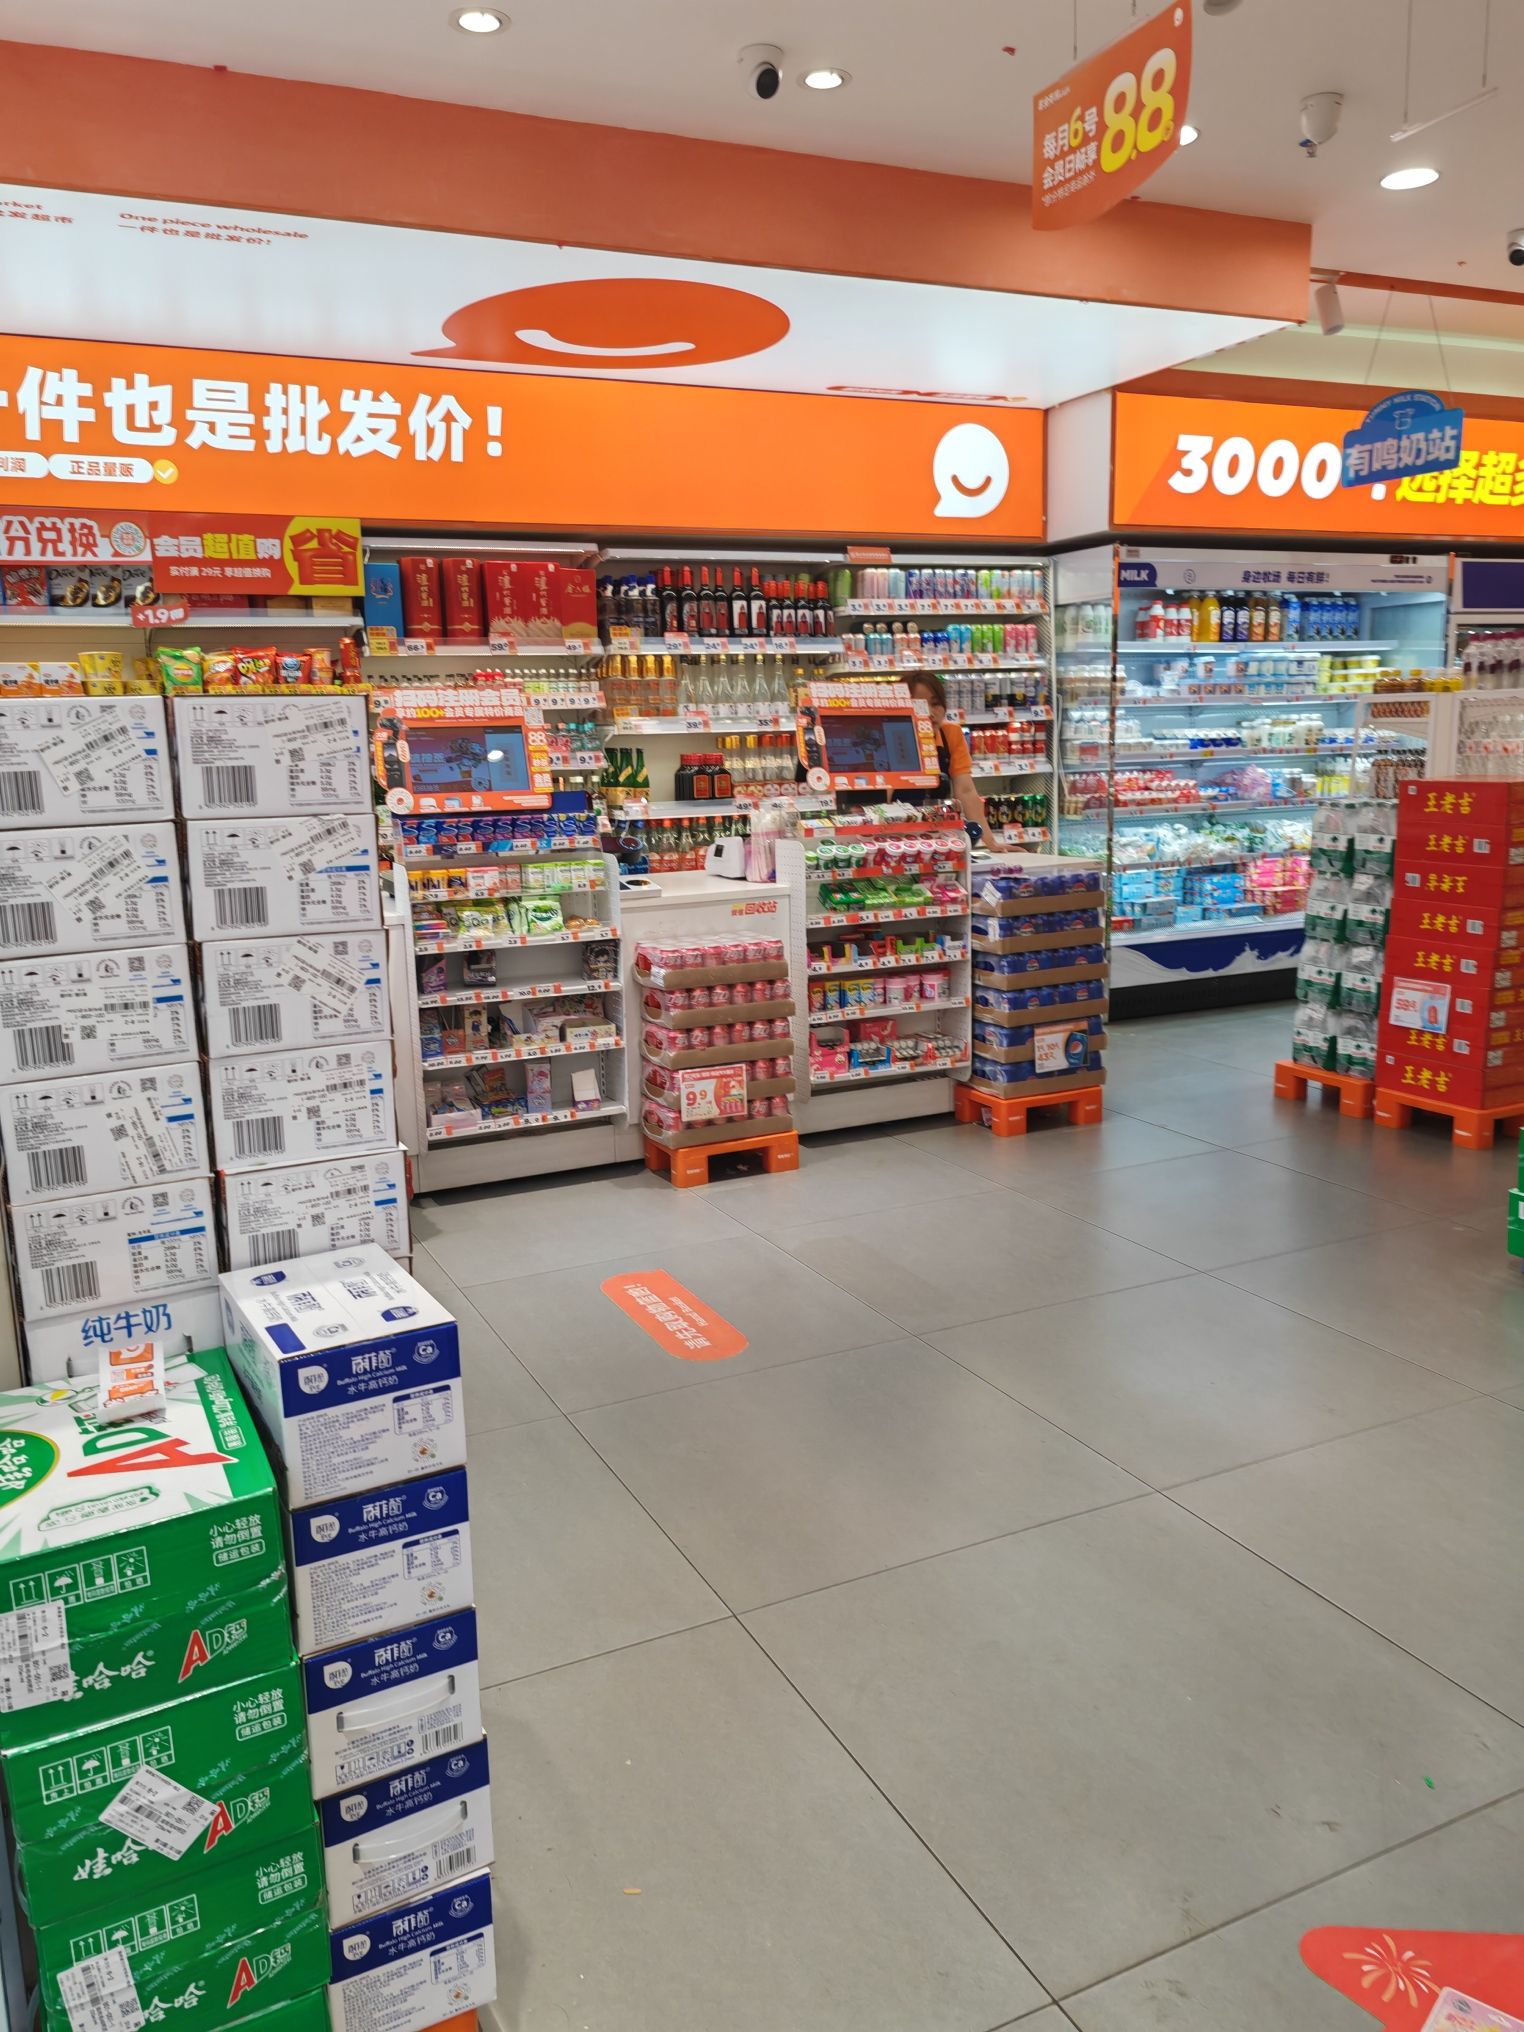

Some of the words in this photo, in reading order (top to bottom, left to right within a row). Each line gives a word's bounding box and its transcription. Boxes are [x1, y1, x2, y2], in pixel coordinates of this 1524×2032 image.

[1042, 106, 1098, 160] 每月6号
[119, 213, 158, 224] One
[162, 217, 212, 229] piece
[216, 223, 310, 239] wholesale
[0, 365, 503, 463] 件也是批发价!
[1345, 426, 1458, 478] 有鸣奶站
[69, 459, 135, 478] 正品量贩
[153, 533, 281, 559] 会员超值购
[289, 528, 360, 586] 省
[1120, 569, 1150, 581] MILK
[1424, 792, 1474, 815] 王老吉
[1425, 834, 1468, 854] 王老吉
[1419, 912, 1462, 934] 王老吉
[1414, 951, 1456, 973] 王老吉
[1401, 1065, 1450, 1093] 王老吉
[81, 1303, 172, 1348] 纯牛奶
[347, 1375, 398, 1395] 水牛高钙奶
[209, 1513, 262, 1537] 小心轻放
[210, 1525, 262, 1549] 请勿倒置
[358, 1521, 408, 1542] 水牛高钙奶
[217, 1544, 262, 1562] 储运包装
[370, 1663, 419, 1686] 水牛高钙奶
[233, 1687, 285, 1712] 小心轻放
[233, 1699, 285, 1725] 请勿倒置
[240, 1716, 283, 1737] 储运包装
[386, 1792, 432, 1816] 水牛高钙奶
[73, 1838, 148, 1881] 娃哈
[255, 1852, 304, 1877] 小心轻放
[256, 1864, 305, 1888] 请勿倒置
[388, 1932, 435, 1956] 水牛高钙奶
[143, 1981, 206, 2022] 哈哈
